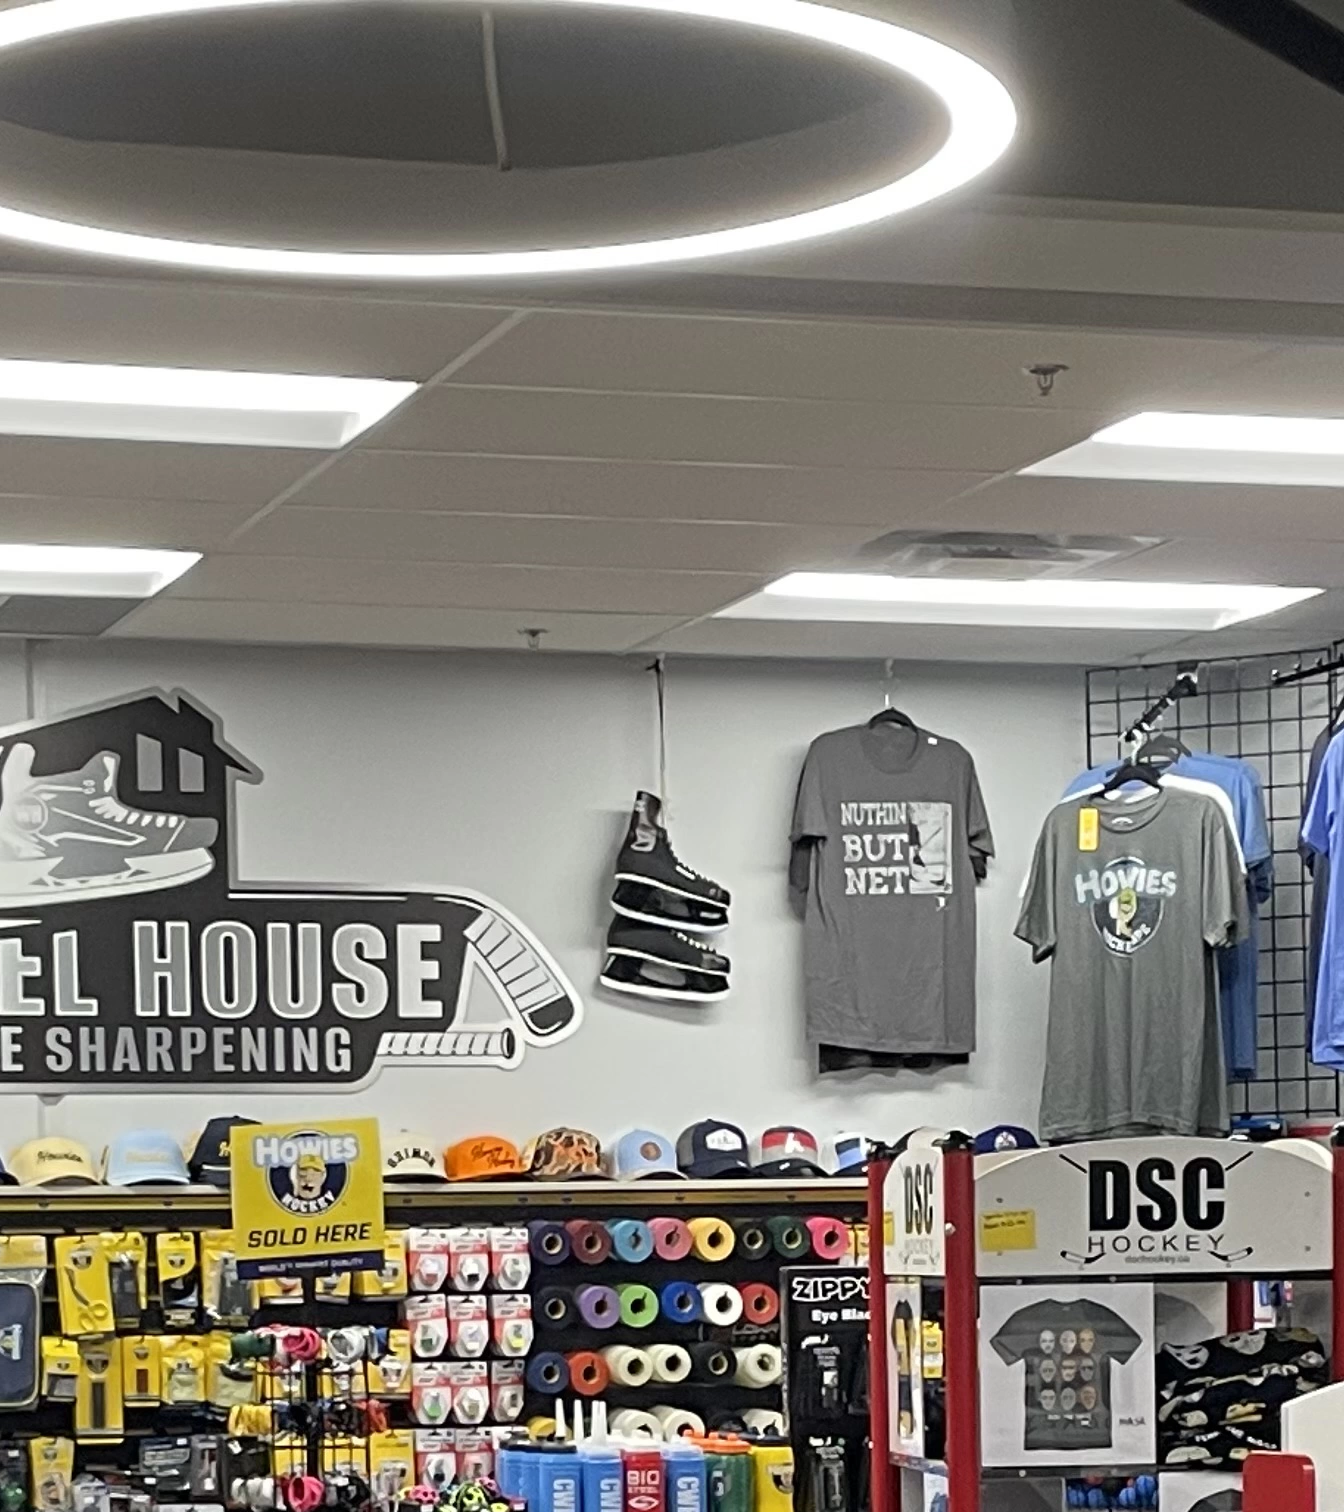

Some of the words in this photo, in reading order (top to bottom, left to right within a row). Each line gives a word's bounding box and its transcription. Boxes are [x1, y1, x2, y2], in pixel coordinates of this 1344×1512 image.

[840, 801, 907, 827] NUTHIN
[842, 832, 909, 863] BUT
[844, 866, 910, 895] NET
[132, 919, 444, 1021] HOUSE
[45, 1027, 354, 1074] SHARPENING
[255, 1136, 358, 1167] HOWIES
[281, 1189, 335, 1213] HOCKEY
[905, 1162, 934, 1236] DSC
[1088, 1157, 1225, 1231] DSC
[248, 1226, 308, 1249] SOLD
[314, 1221, 373, 1244] HERE
[1088, 1233, 1225, 1253] HOCKEY
[792, 1276, 871, 1301] ZIPPY
[811, 1309, 838, 1323] Eye
[841, 1309, 871, 1321] Blac
